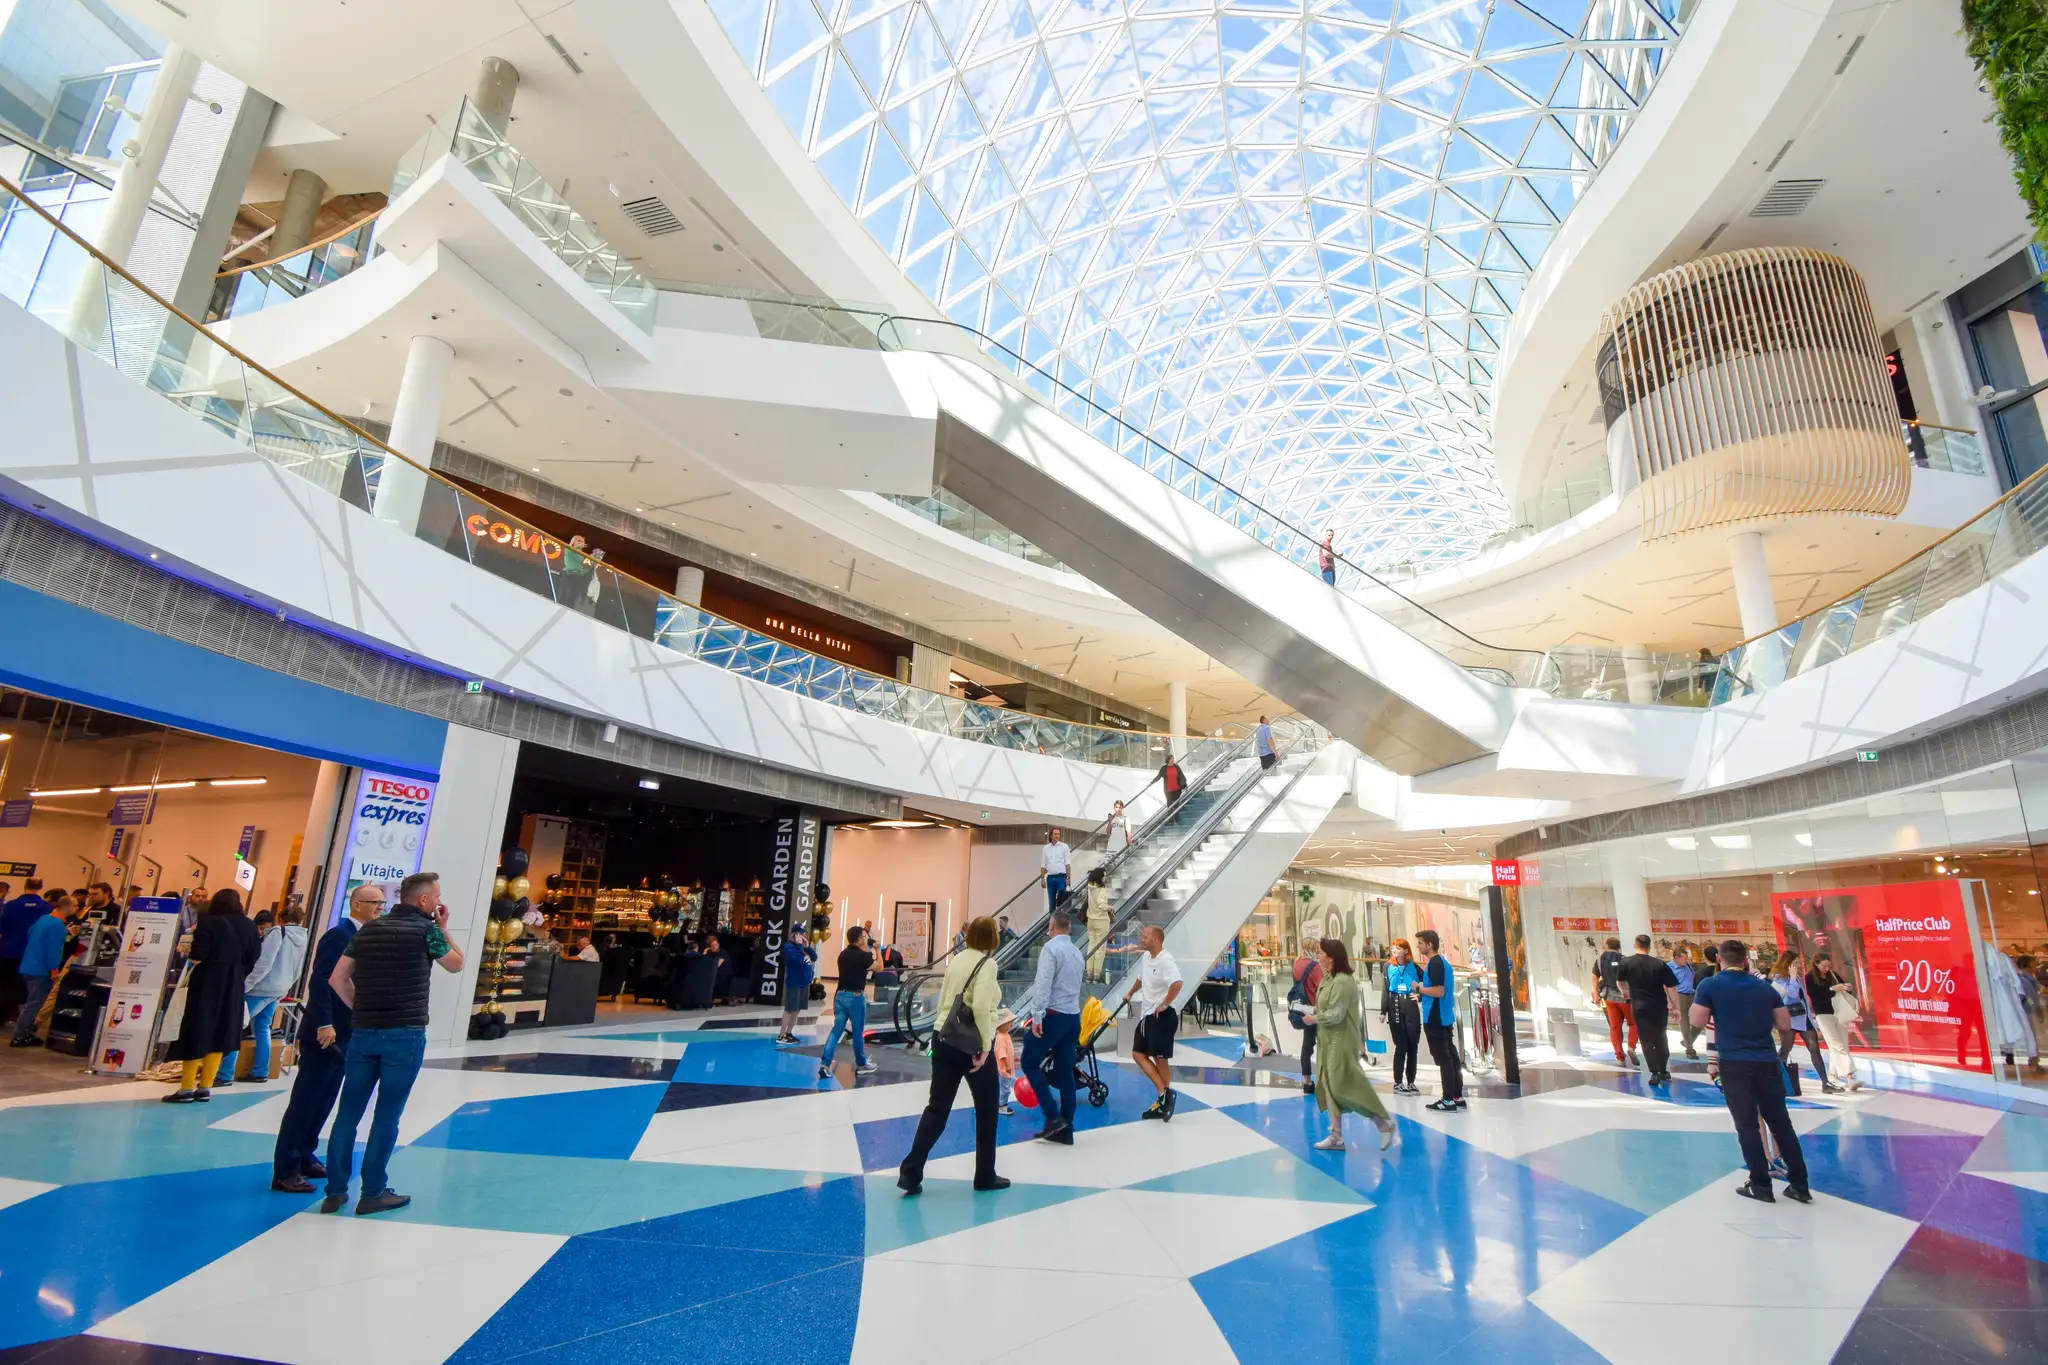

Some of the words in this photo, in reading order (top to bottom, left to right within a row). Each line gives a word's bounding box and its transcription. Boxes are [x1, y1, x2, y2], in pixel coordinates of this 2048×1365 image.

[467, 514, 561, 559] COMO
[766, 617, 784, 630] UNA
[791, 625, 820, 642] BELLA
[368, 778, 430, 801] TESCO
[360, 804, 426, 826] expres
[114, 868, 121, 876] 2
[146, 869, 154, 878] 3
[192, 869, 200, 878] 4
[242, 870, 250, 879] 5
[769, 818, 794, 911] GARDEN
[795, 819, 817, 912] GARDEN
[1495, 865, 1515, 874] Half
[1876, 918, 1923, 932] HalfPrice
[1924, 916, 1951, 931] Club
[761, 919, 784, 997] BLACK
[1887, 960, 1955, 994] -20%
